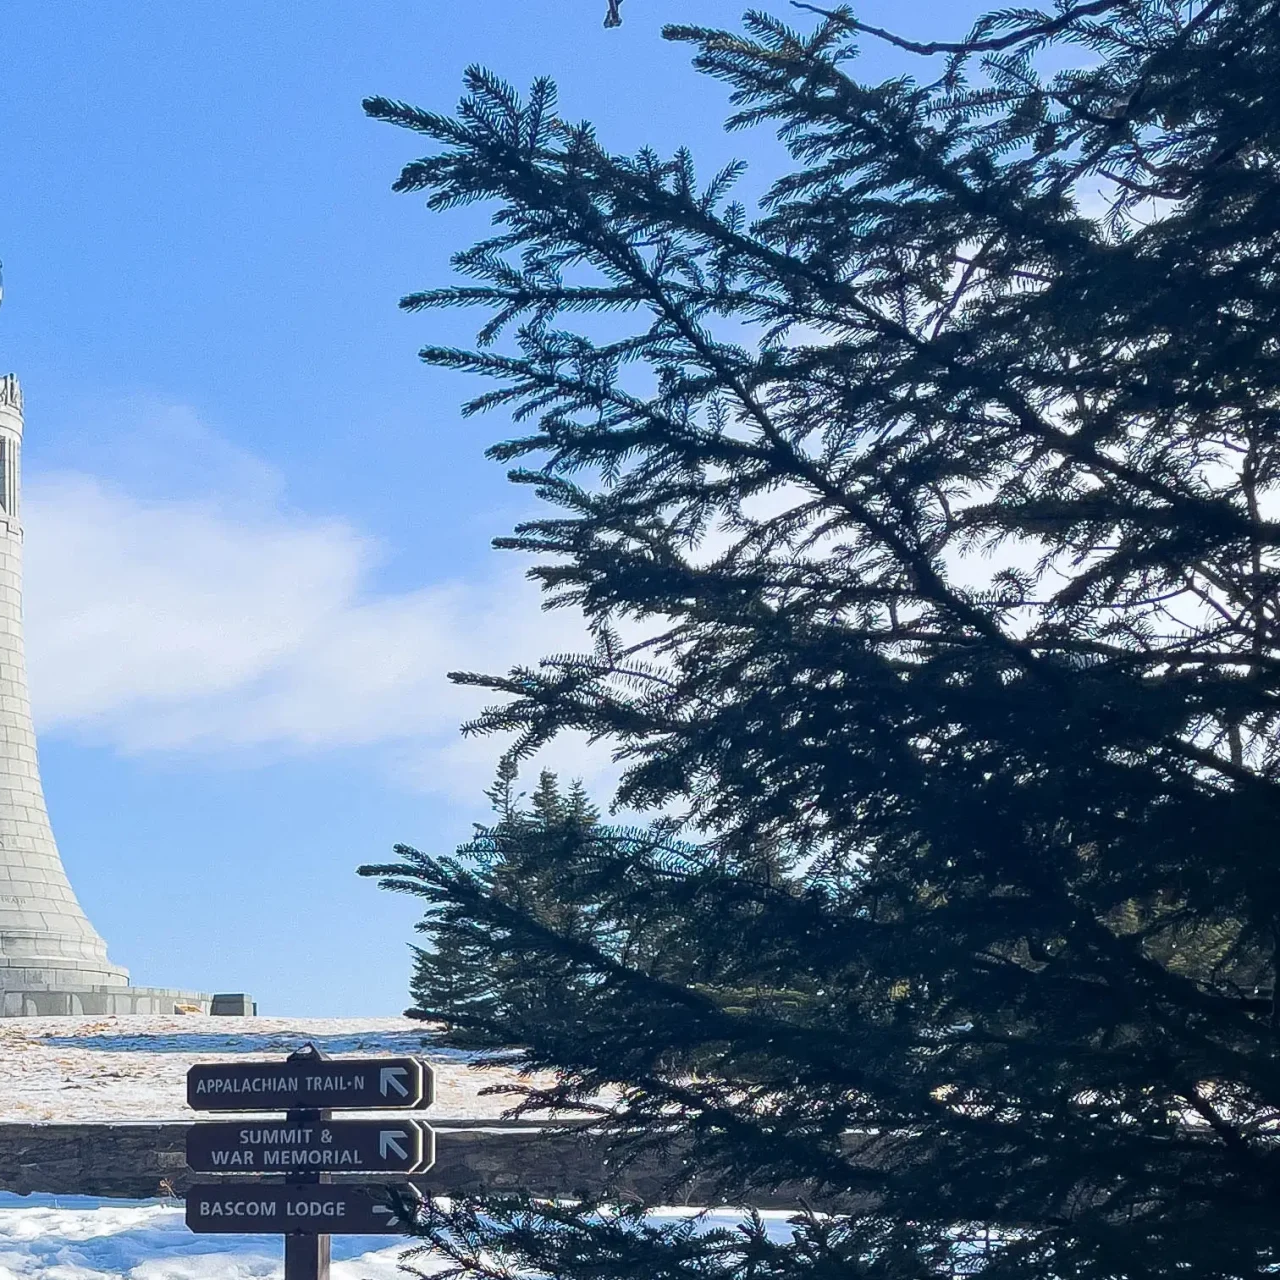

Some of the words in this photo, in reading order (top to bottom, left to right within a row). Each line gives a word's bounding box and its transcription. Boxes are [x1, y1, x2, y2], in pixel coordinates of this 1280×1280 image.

[196, 1078, 297, 1093] APPALACHIAN
[240, 1129, 313, 1143] SUMMIT
[321, 1129, 332, 1143] &
[212, 1151, 253, 1164] WAR
[264, 1150, 362, 1164] MEMORIAL
[200, 1202, 275, 1216] BASCOM
[287, 1202, 345, 1216] LODGE
